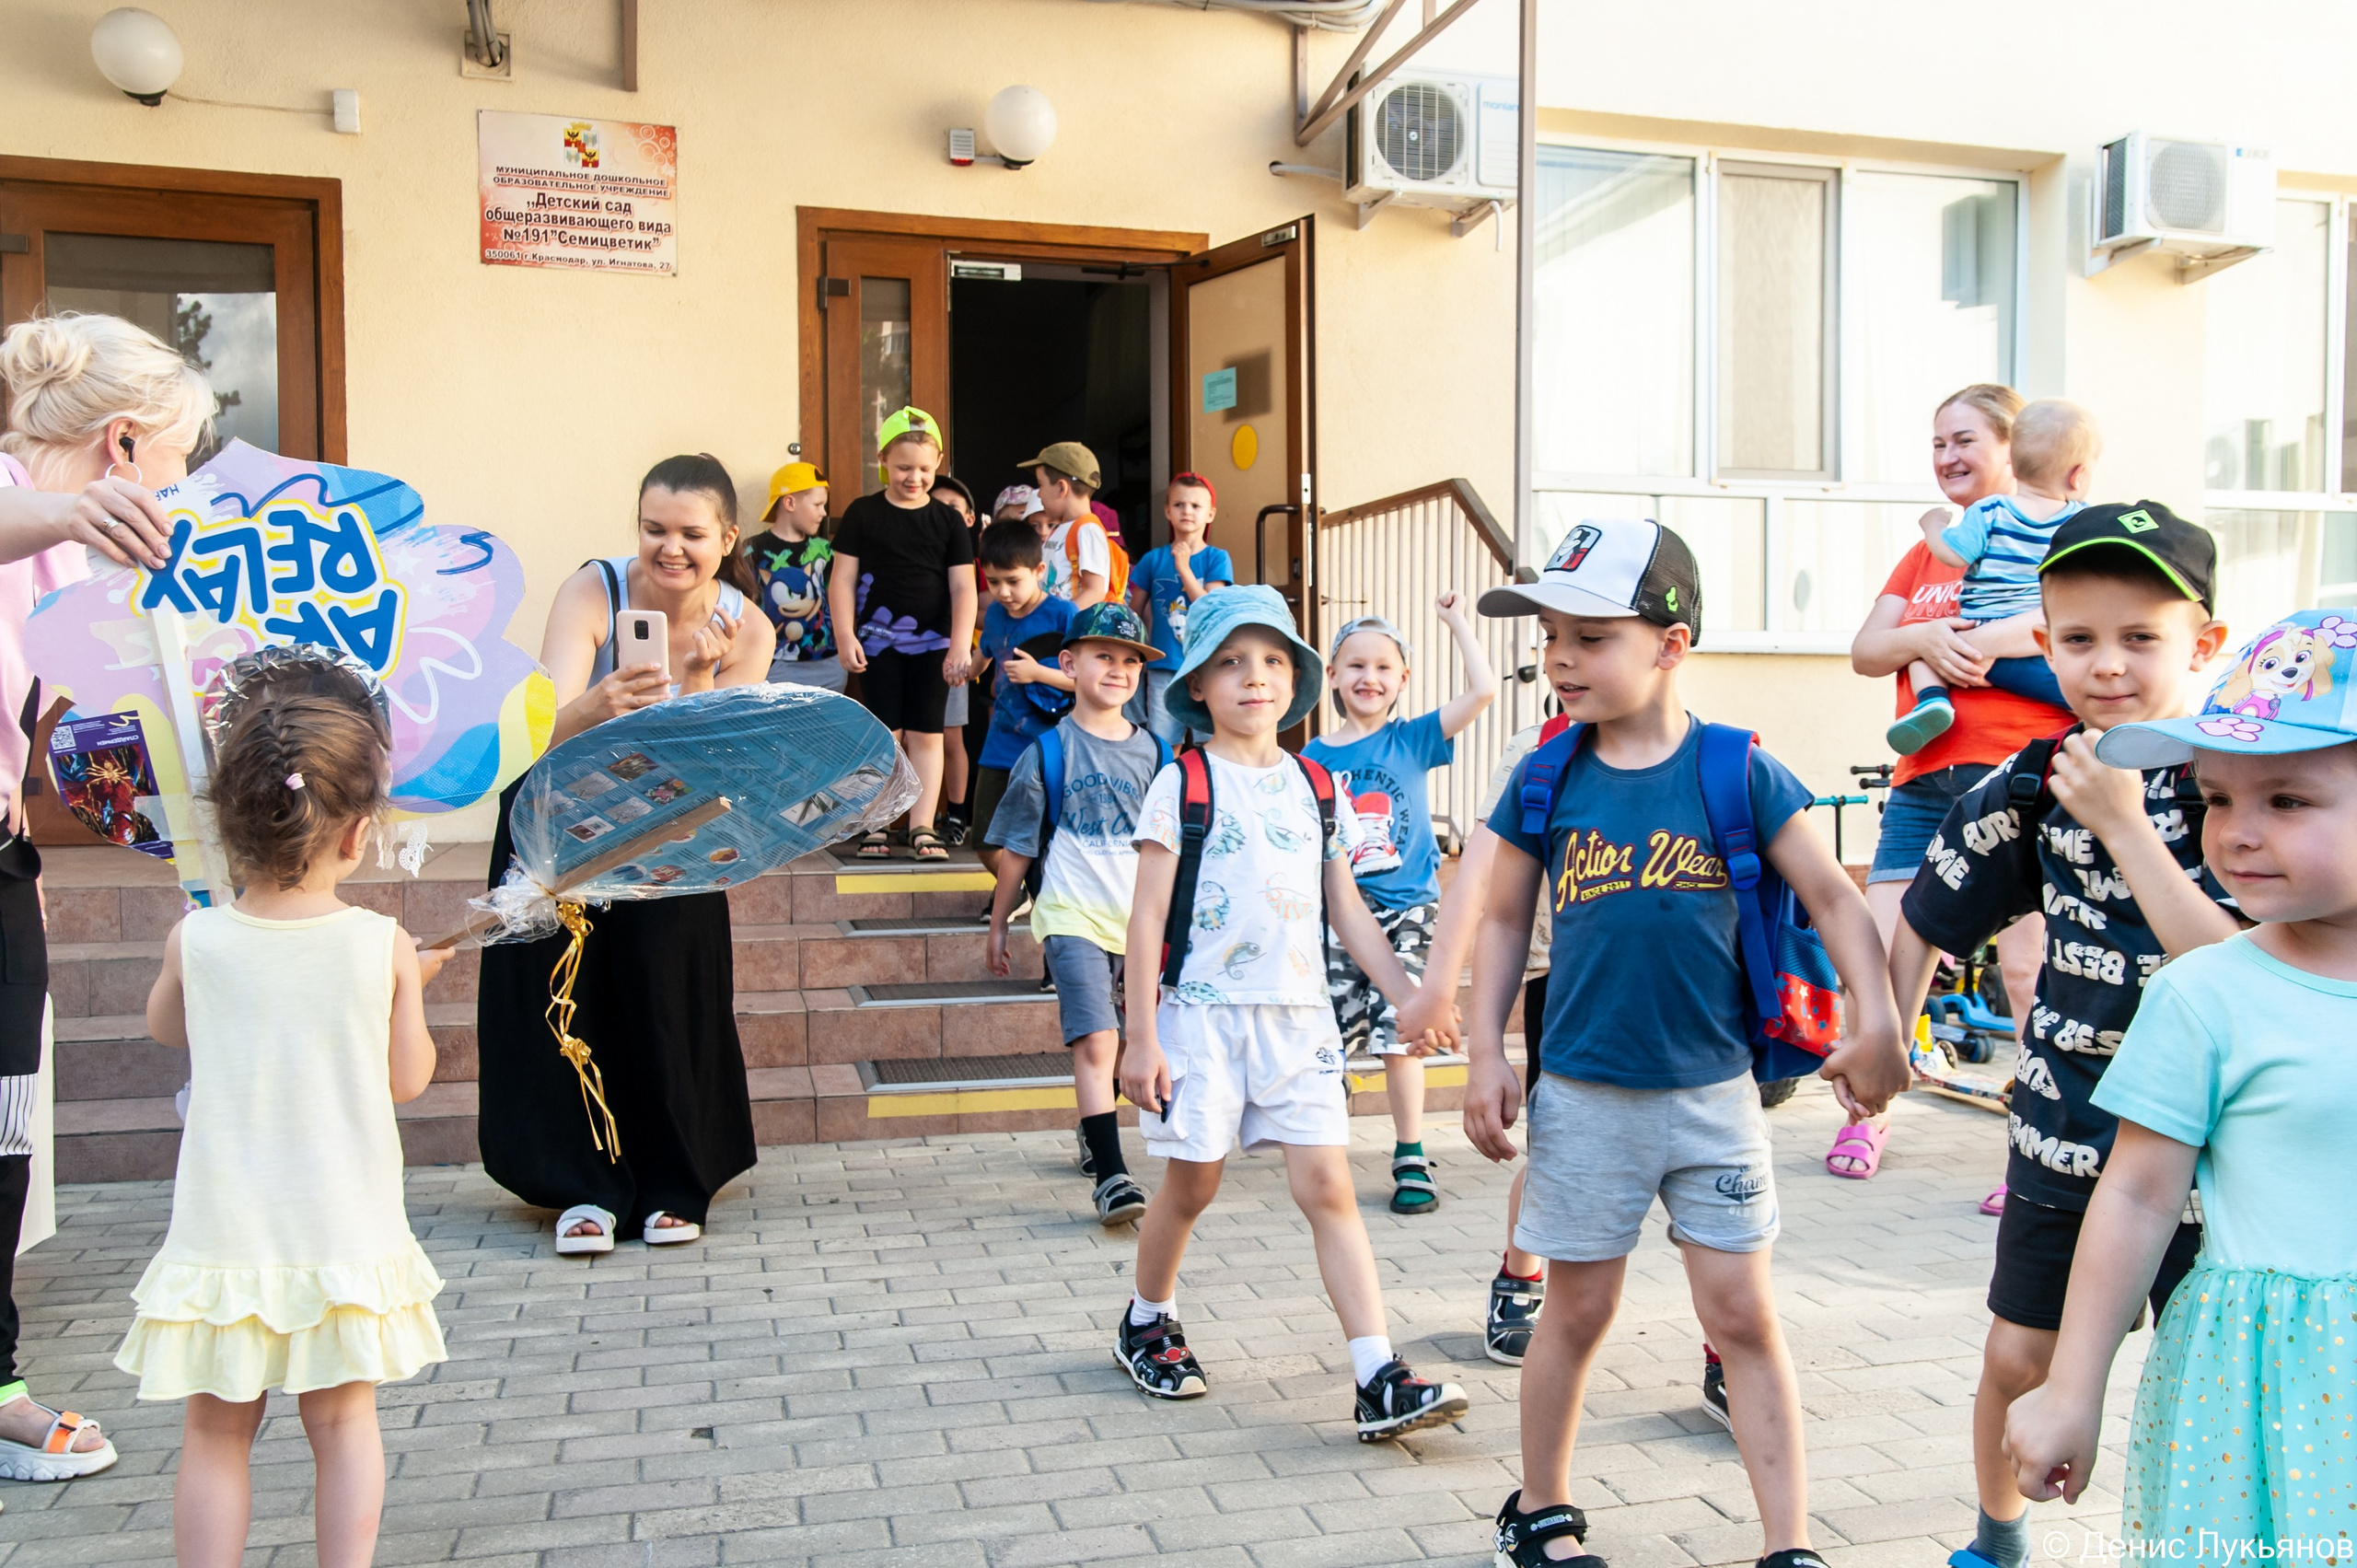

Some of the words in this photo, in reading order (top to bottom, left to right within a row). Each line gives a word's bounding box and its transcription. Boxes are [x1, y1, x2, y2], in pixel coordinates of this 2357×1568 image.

[493, 176, 597, 192] ОБРАЗОВАТЕЛЬНОЕ
[600, 185, 669, 197] УЧРЕЖДЕНИЕ
[495, 166, 590, 180] МУНИЦИПАЛЬНОЕ
[593, 174, 667, 187] ДОШКОЛЬНОЕ
[486, 207, 633, 231] общеразвивающего
[638, 221, 671, 234] вида
[605, 201, 632, 215] сад
[486, 250, 521, 260] 350061
[592, 257, 606, 266] ул.
[609, 257, 656, 270] Игнатова,
[659, 261, 671, 270] 27
[142, 509, 377, 623] RELAX
[1352, 768, 1405, 804] HENTIC
[1556, 830, 1633, 912] Action
[1641, 829, 1728, 889] Wear
[1583, 887, 1604, 900] SINCE
[2052, 939, 2125, 986] BEST
[2054, 1018, 2125, 1057] BES
[2009, 1111, 2101, 1178] MMER
